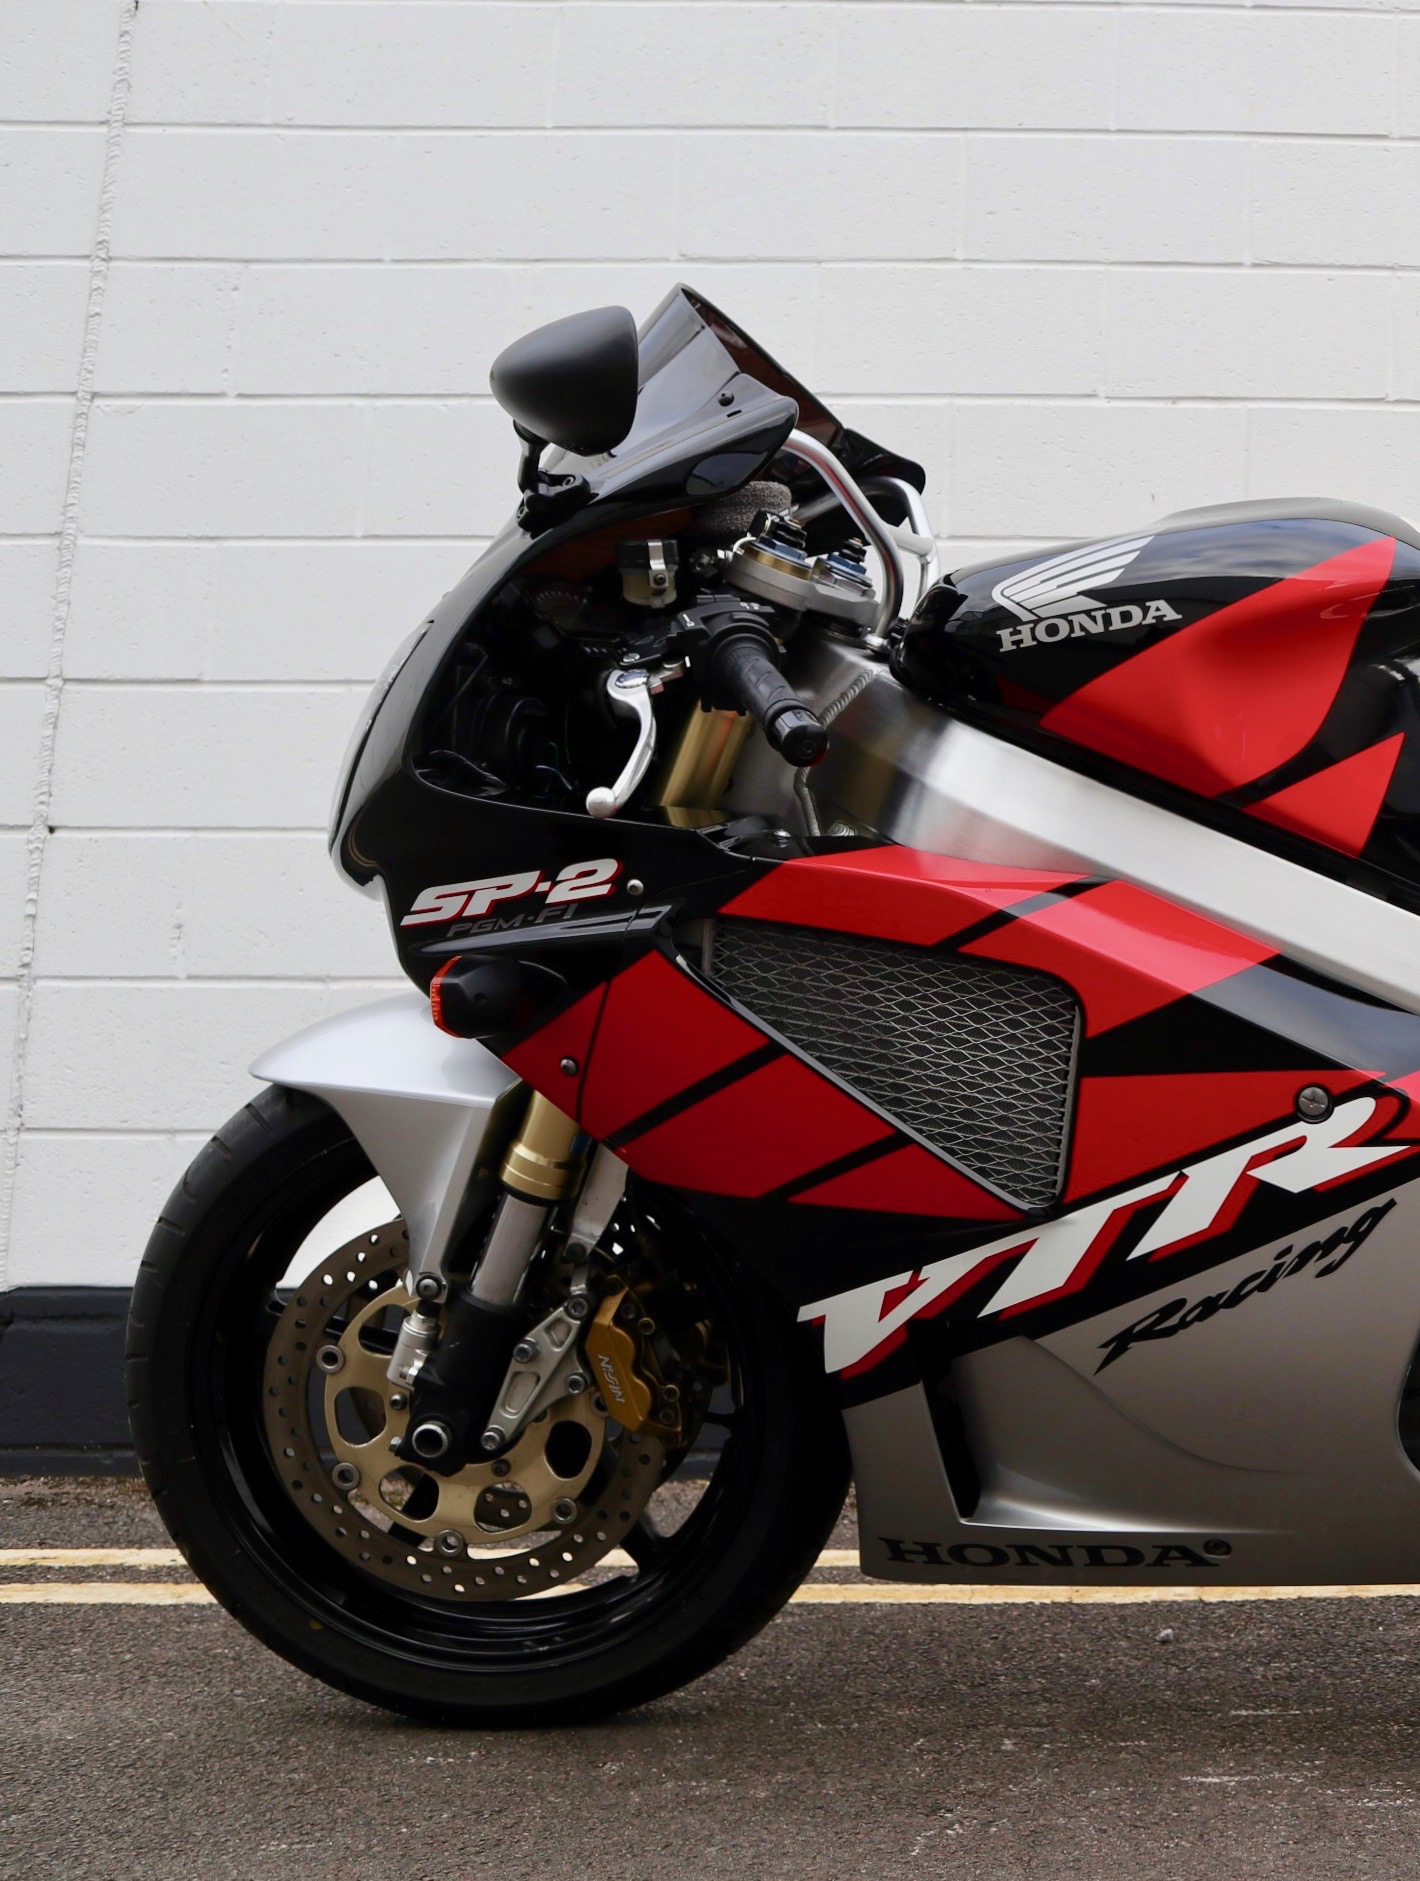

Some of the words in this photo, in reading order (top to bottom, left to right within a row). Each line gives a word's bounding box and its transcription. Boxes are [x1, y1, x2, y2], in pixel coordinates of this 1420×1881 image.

[996, 599, 1183, 652] HONDA
[400, 857, 623, 928] SP-2
[797, 1096, 1415, 1376] VTR
[1092, 1197, 1398, 1378] Racing
[877, 1537, 1219, 1568] HONDA
